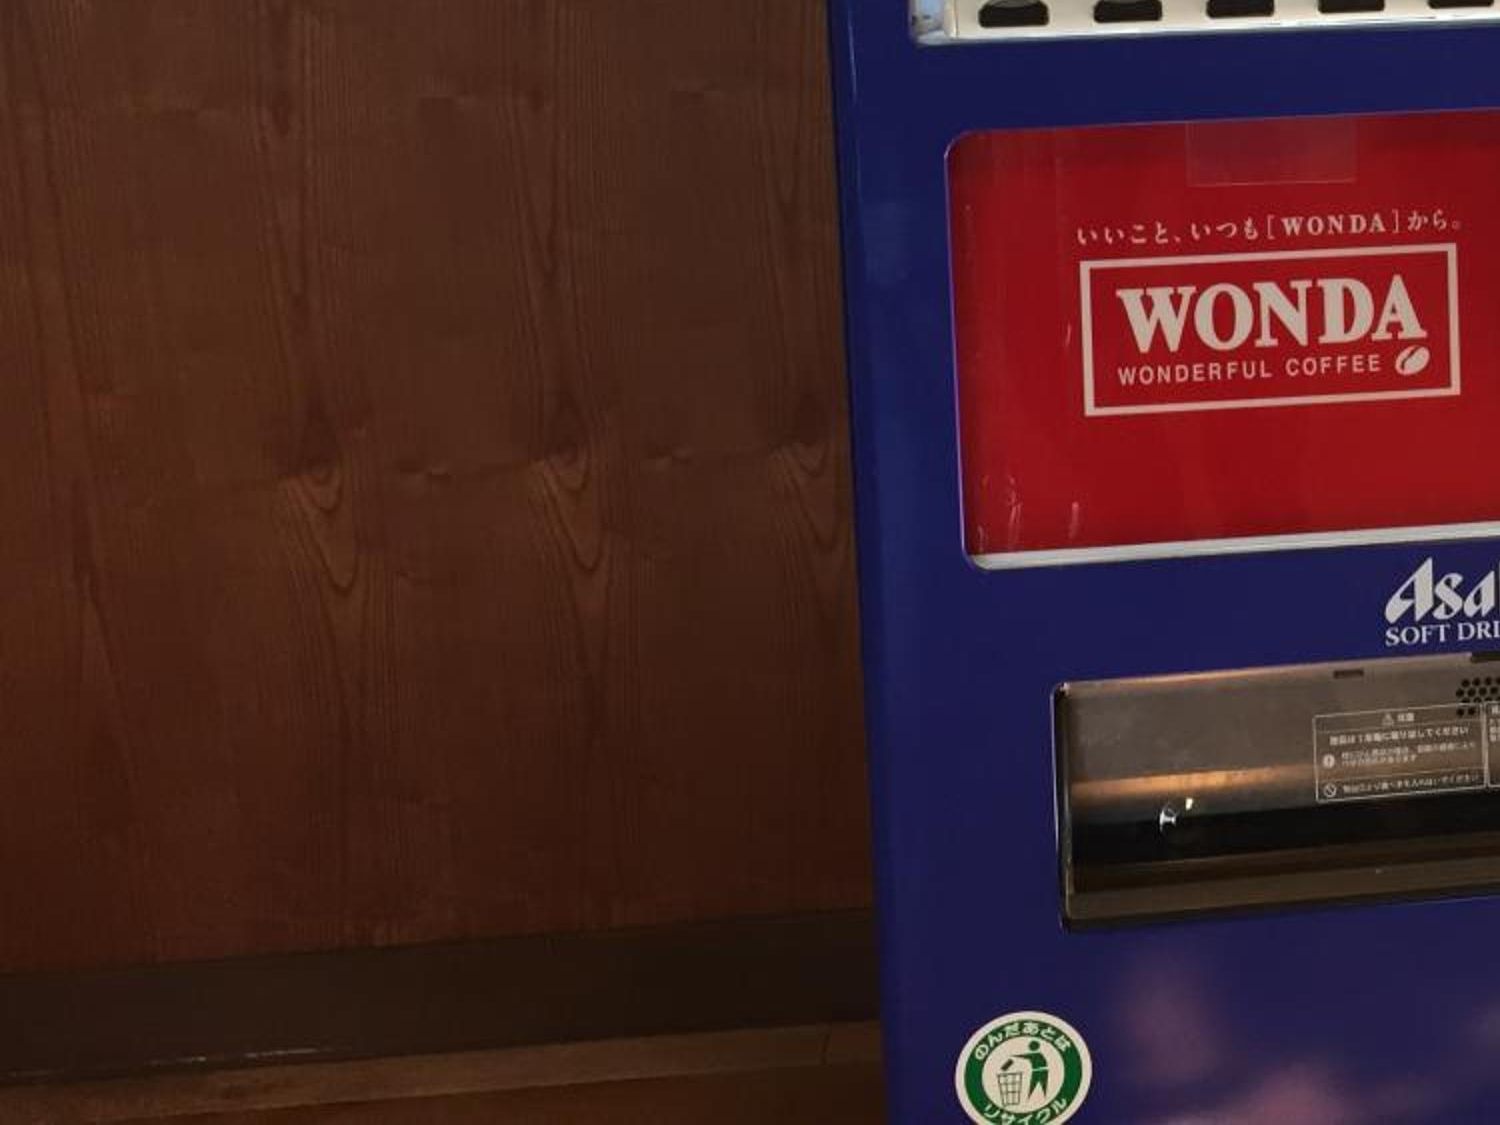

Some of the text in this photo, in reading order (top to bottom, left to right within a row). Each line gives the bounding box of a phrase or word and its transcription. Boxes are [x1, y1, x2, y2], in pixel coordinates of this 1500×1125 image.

[1115, 274, 1428, 354] WONDA
[1117, 353, 1382, 386] WONDERFUL COFFEE
[1384, 623, 1452, 647] SOFT
[974, 1022, 1072, 1061] のんだあとは
